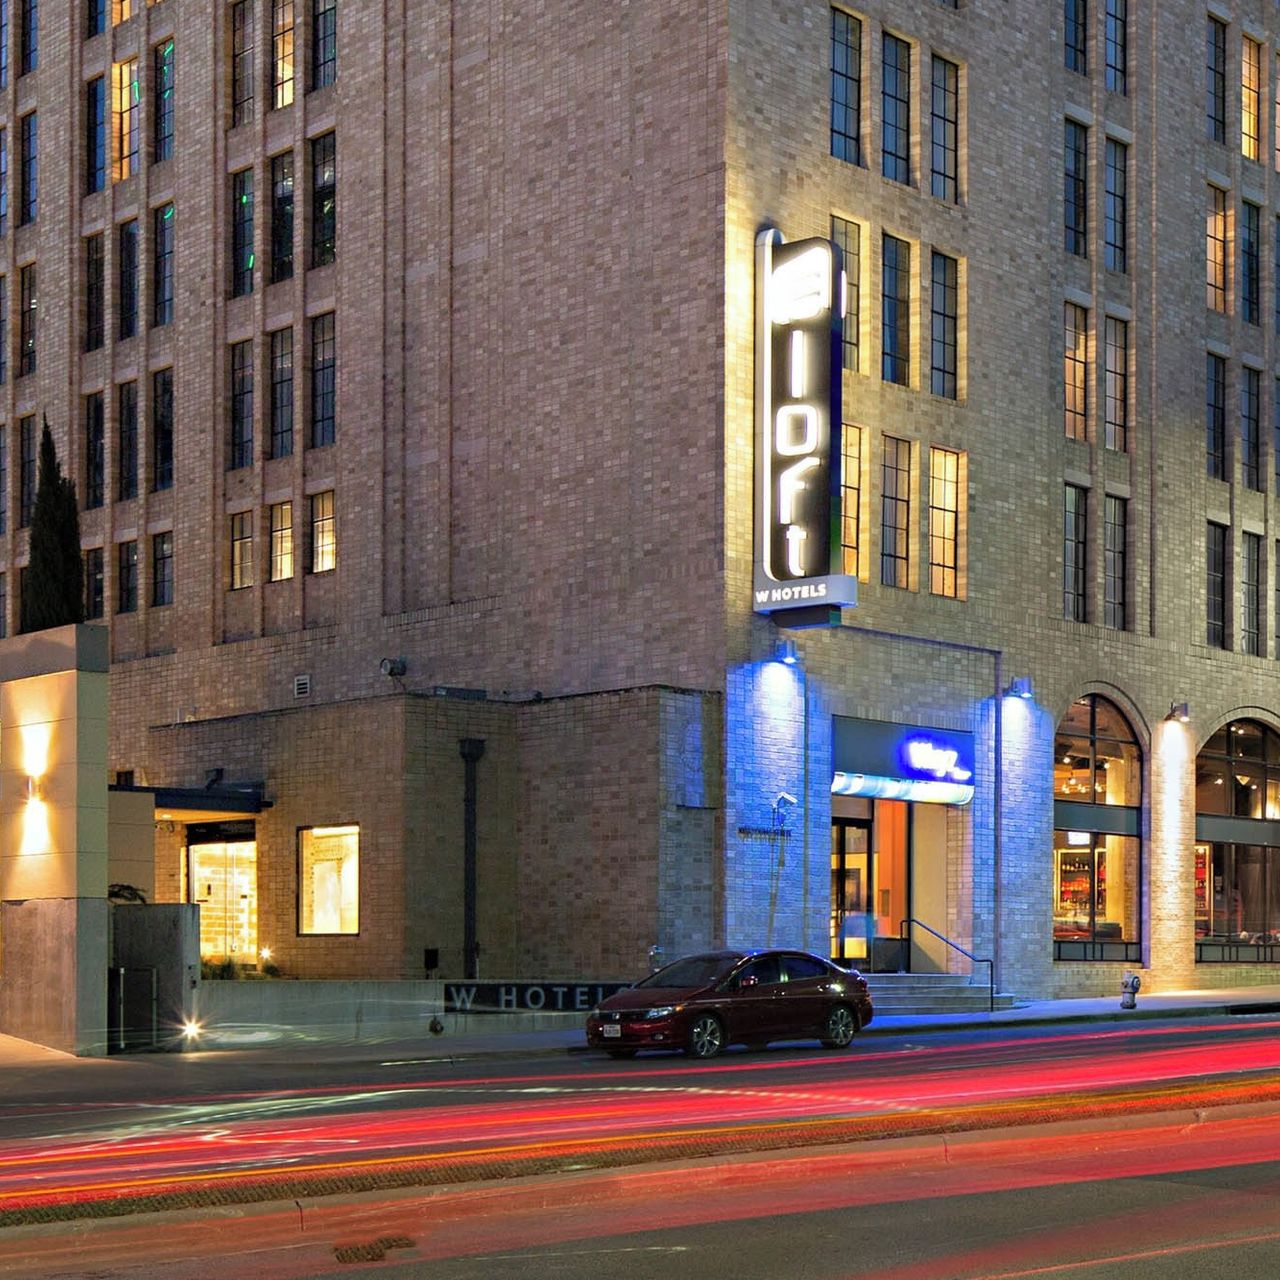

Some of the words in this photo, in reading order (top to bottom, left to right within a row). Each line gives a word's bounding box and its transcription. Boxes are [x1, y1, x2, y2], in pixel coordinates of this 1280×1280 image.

[756, 590, 769, 603] W
[772, 583, 826, 602] HOTELS
[450, 986, 477, 1010] W
[499, 986, 628, 1010] HOTEL
